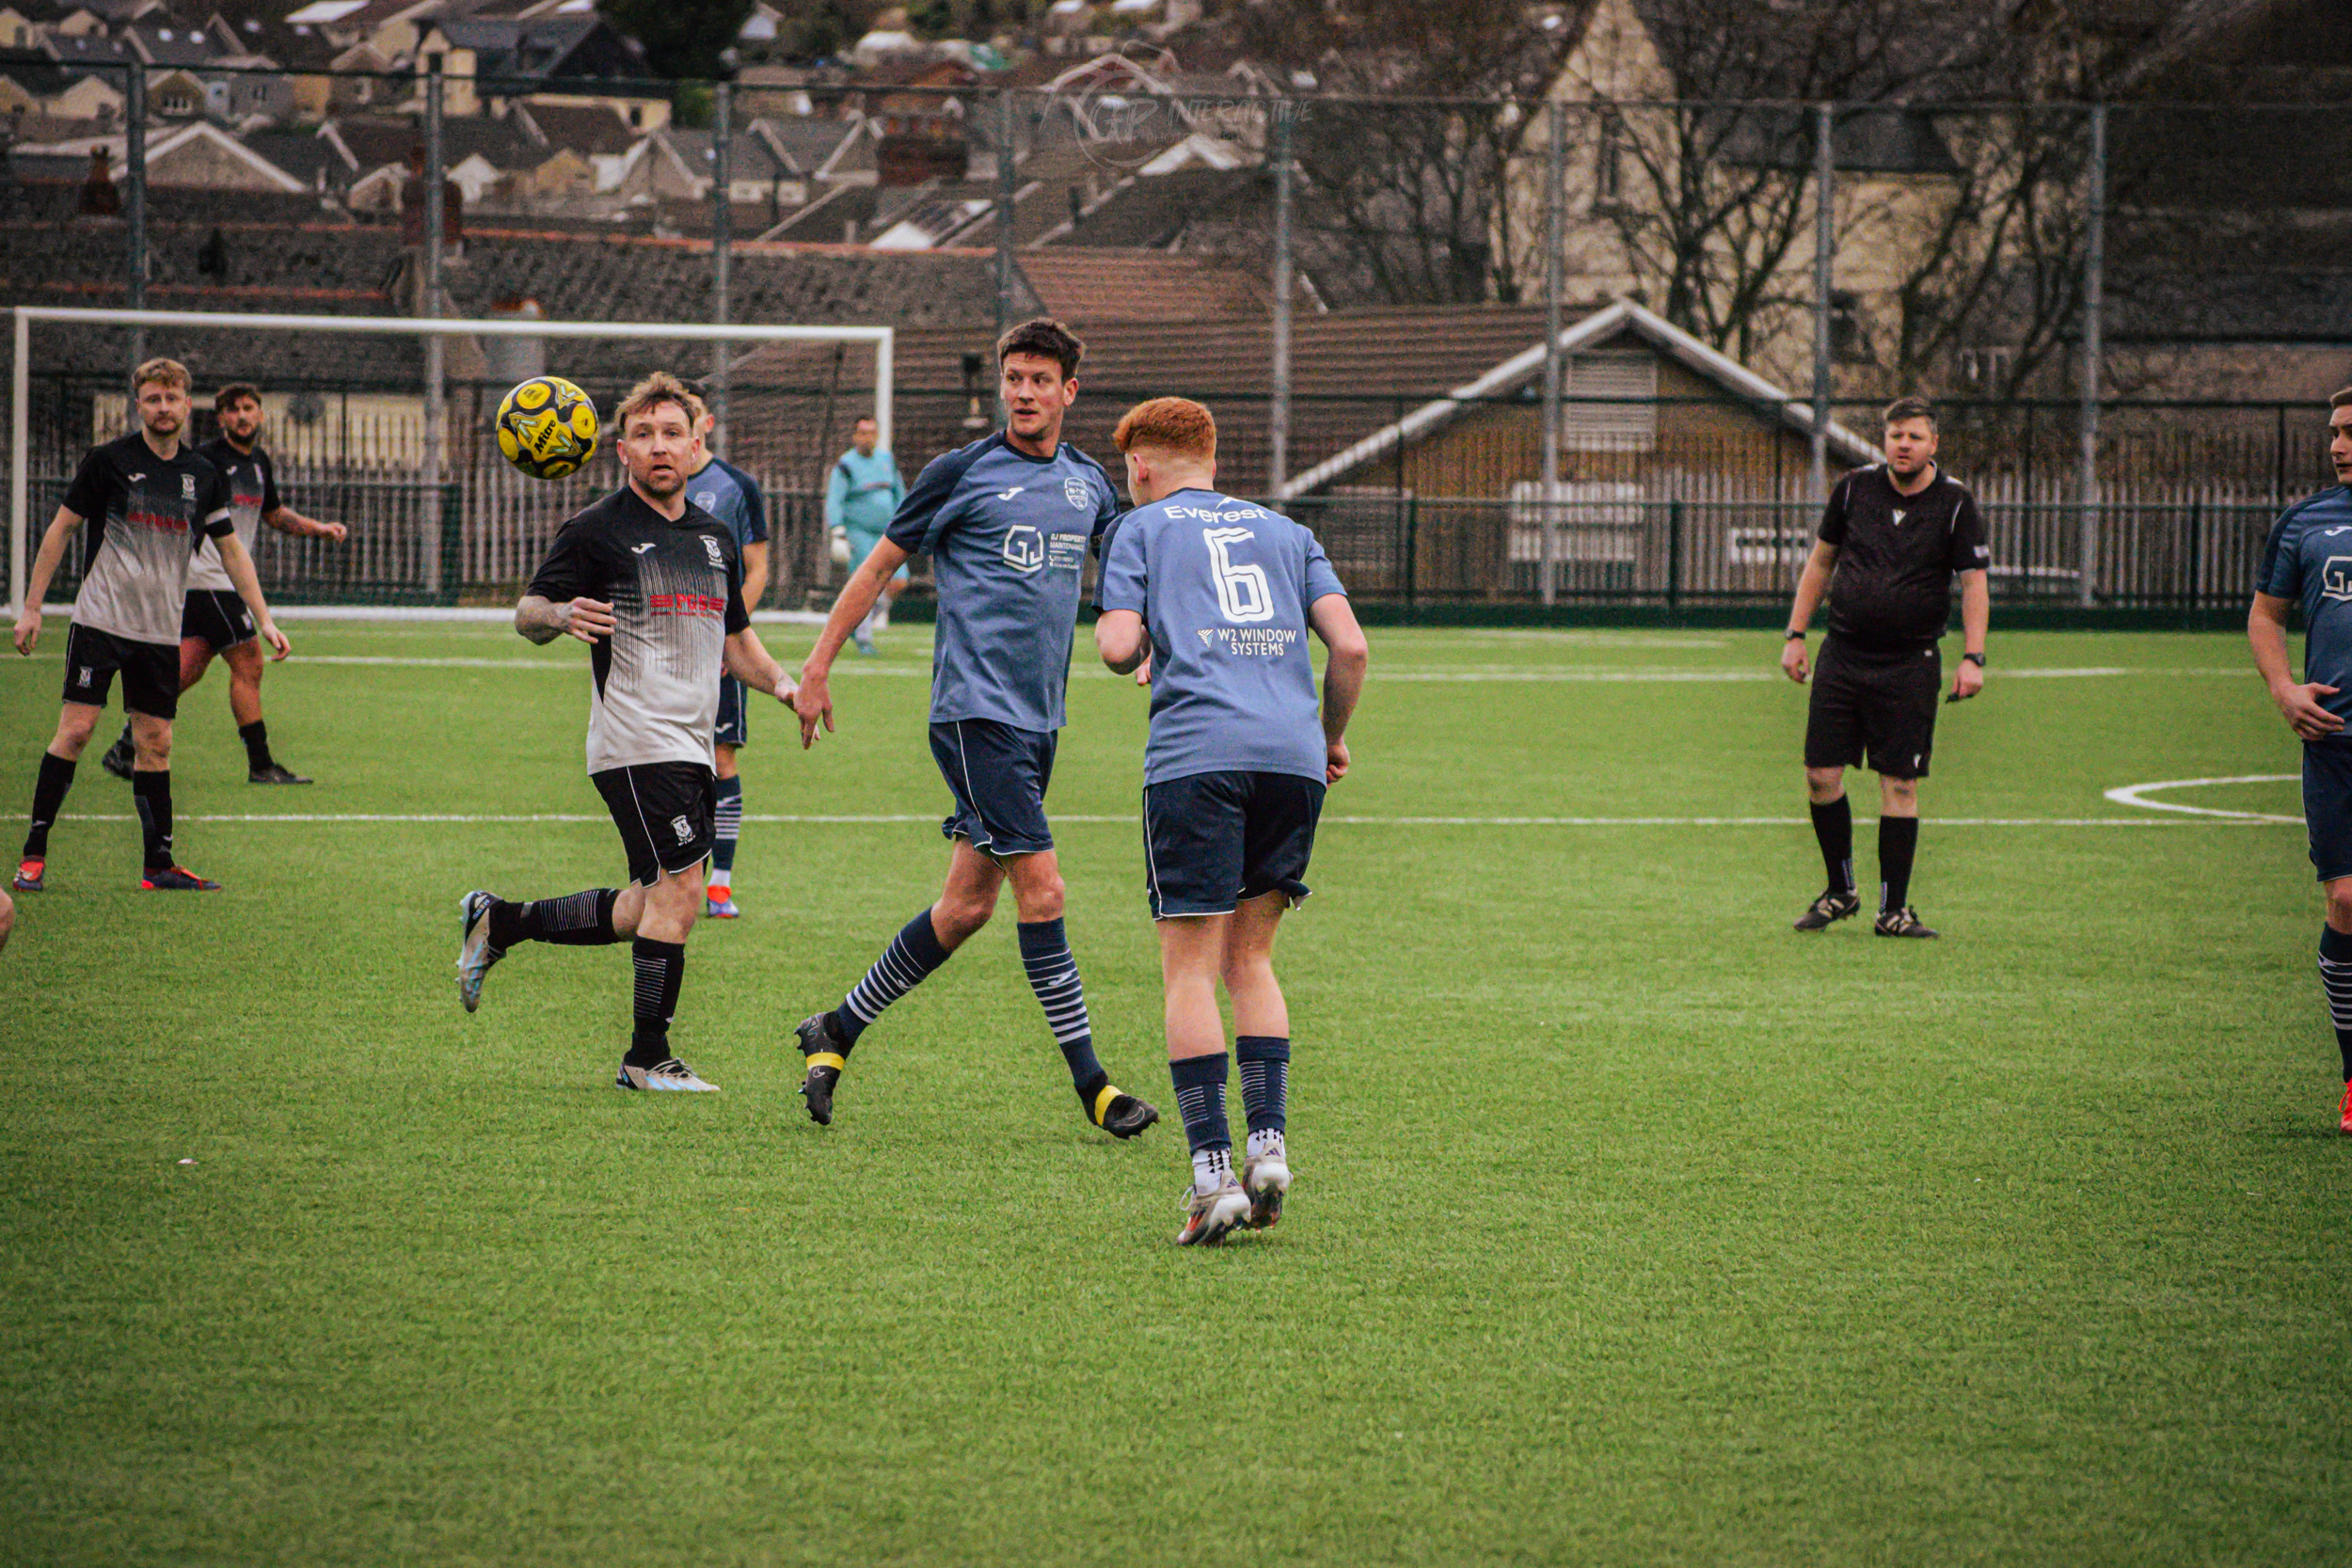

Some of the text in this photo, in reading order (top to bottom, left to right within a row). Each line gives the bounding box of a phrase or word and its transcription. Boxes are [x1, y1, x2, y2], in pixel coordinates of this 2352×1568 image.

[1163, 505, 1269, 524] Everest
[1202, 527, 1275, 624] 6
[675, 593, 708, 611] PGS
[1216, 628, 1297, 643] W2 WINDOW
[1231, 641, 1285, 657] SYSTEMS
